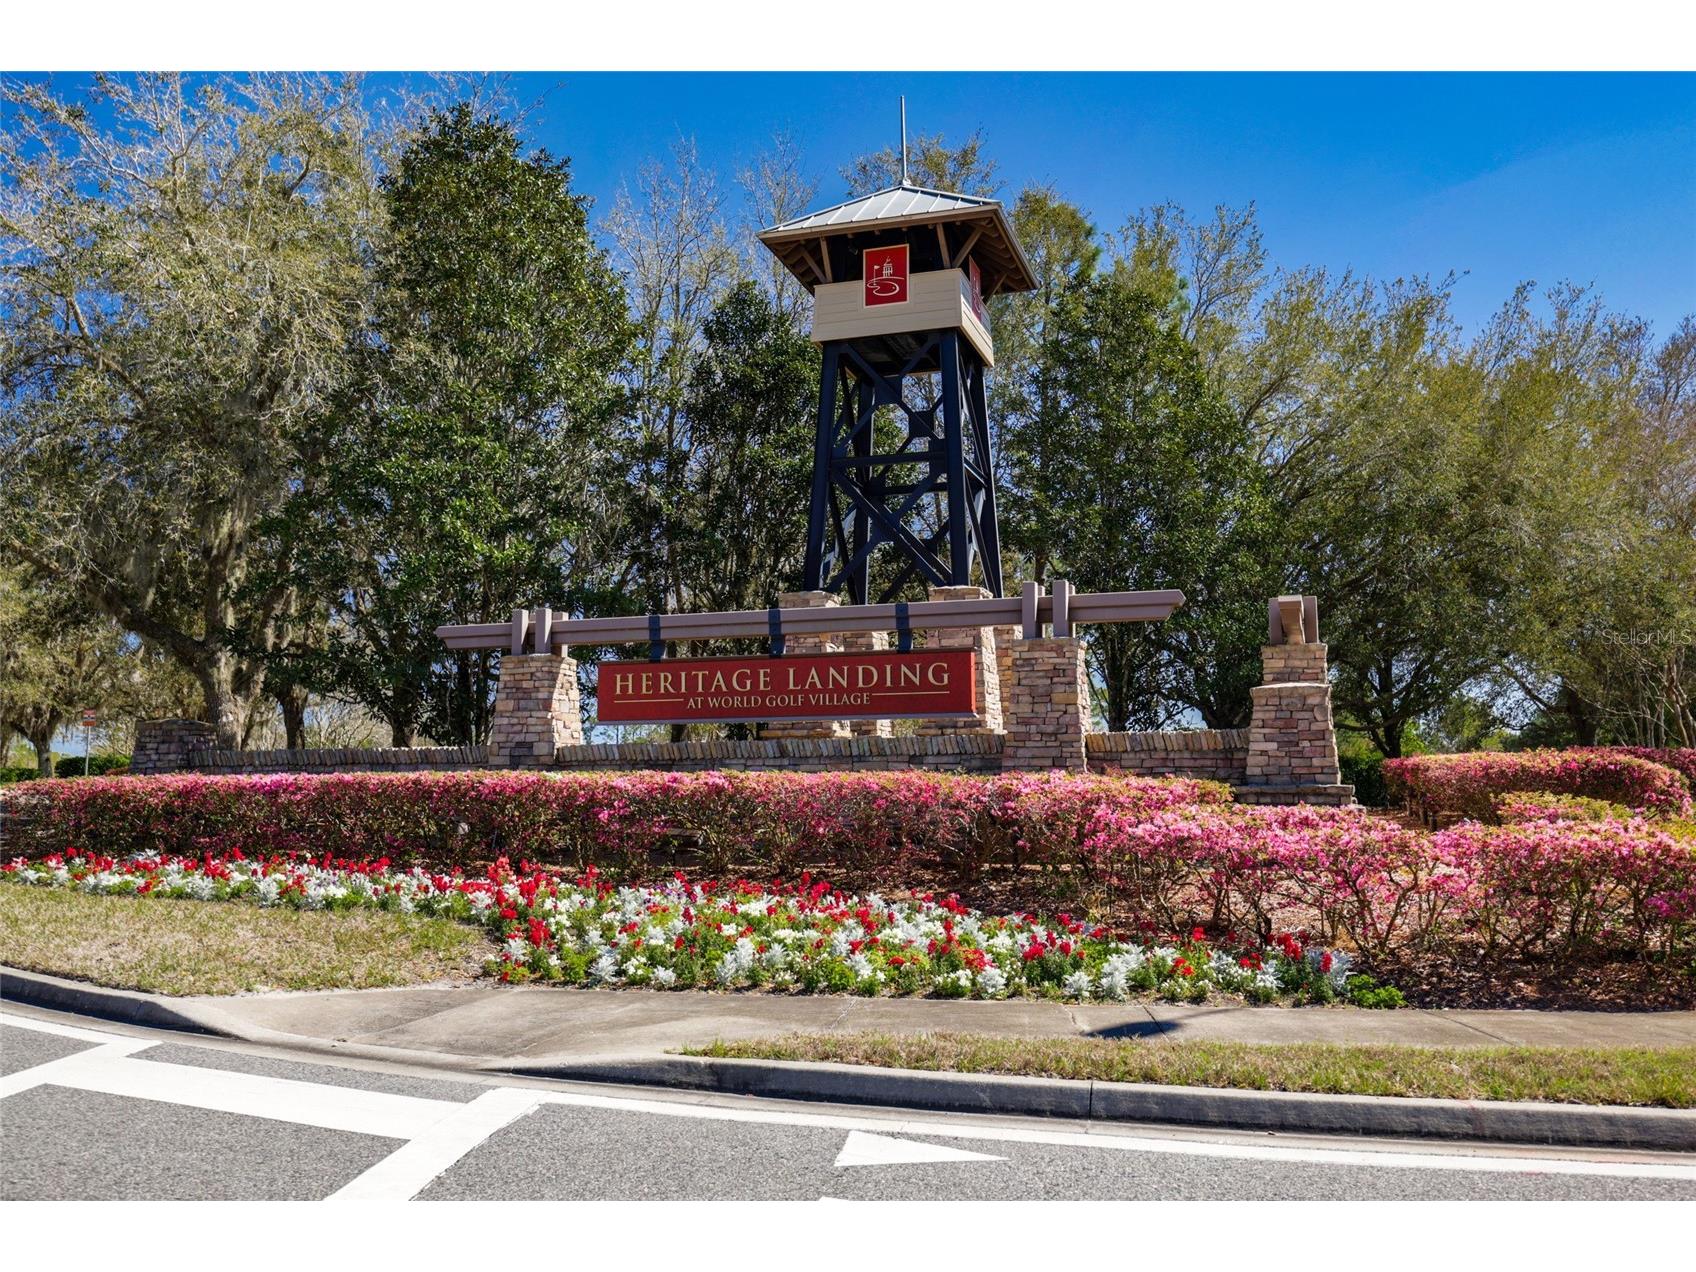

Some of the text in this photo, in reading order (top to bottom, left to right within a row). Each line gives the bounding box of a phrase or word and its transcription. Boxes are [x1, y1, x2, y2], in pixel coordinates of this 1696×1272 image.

[614, 662, 951, 695] HERITAGE LANDING
[686, 692, 871, 709] AT WORLD GOLF VILLAGE
